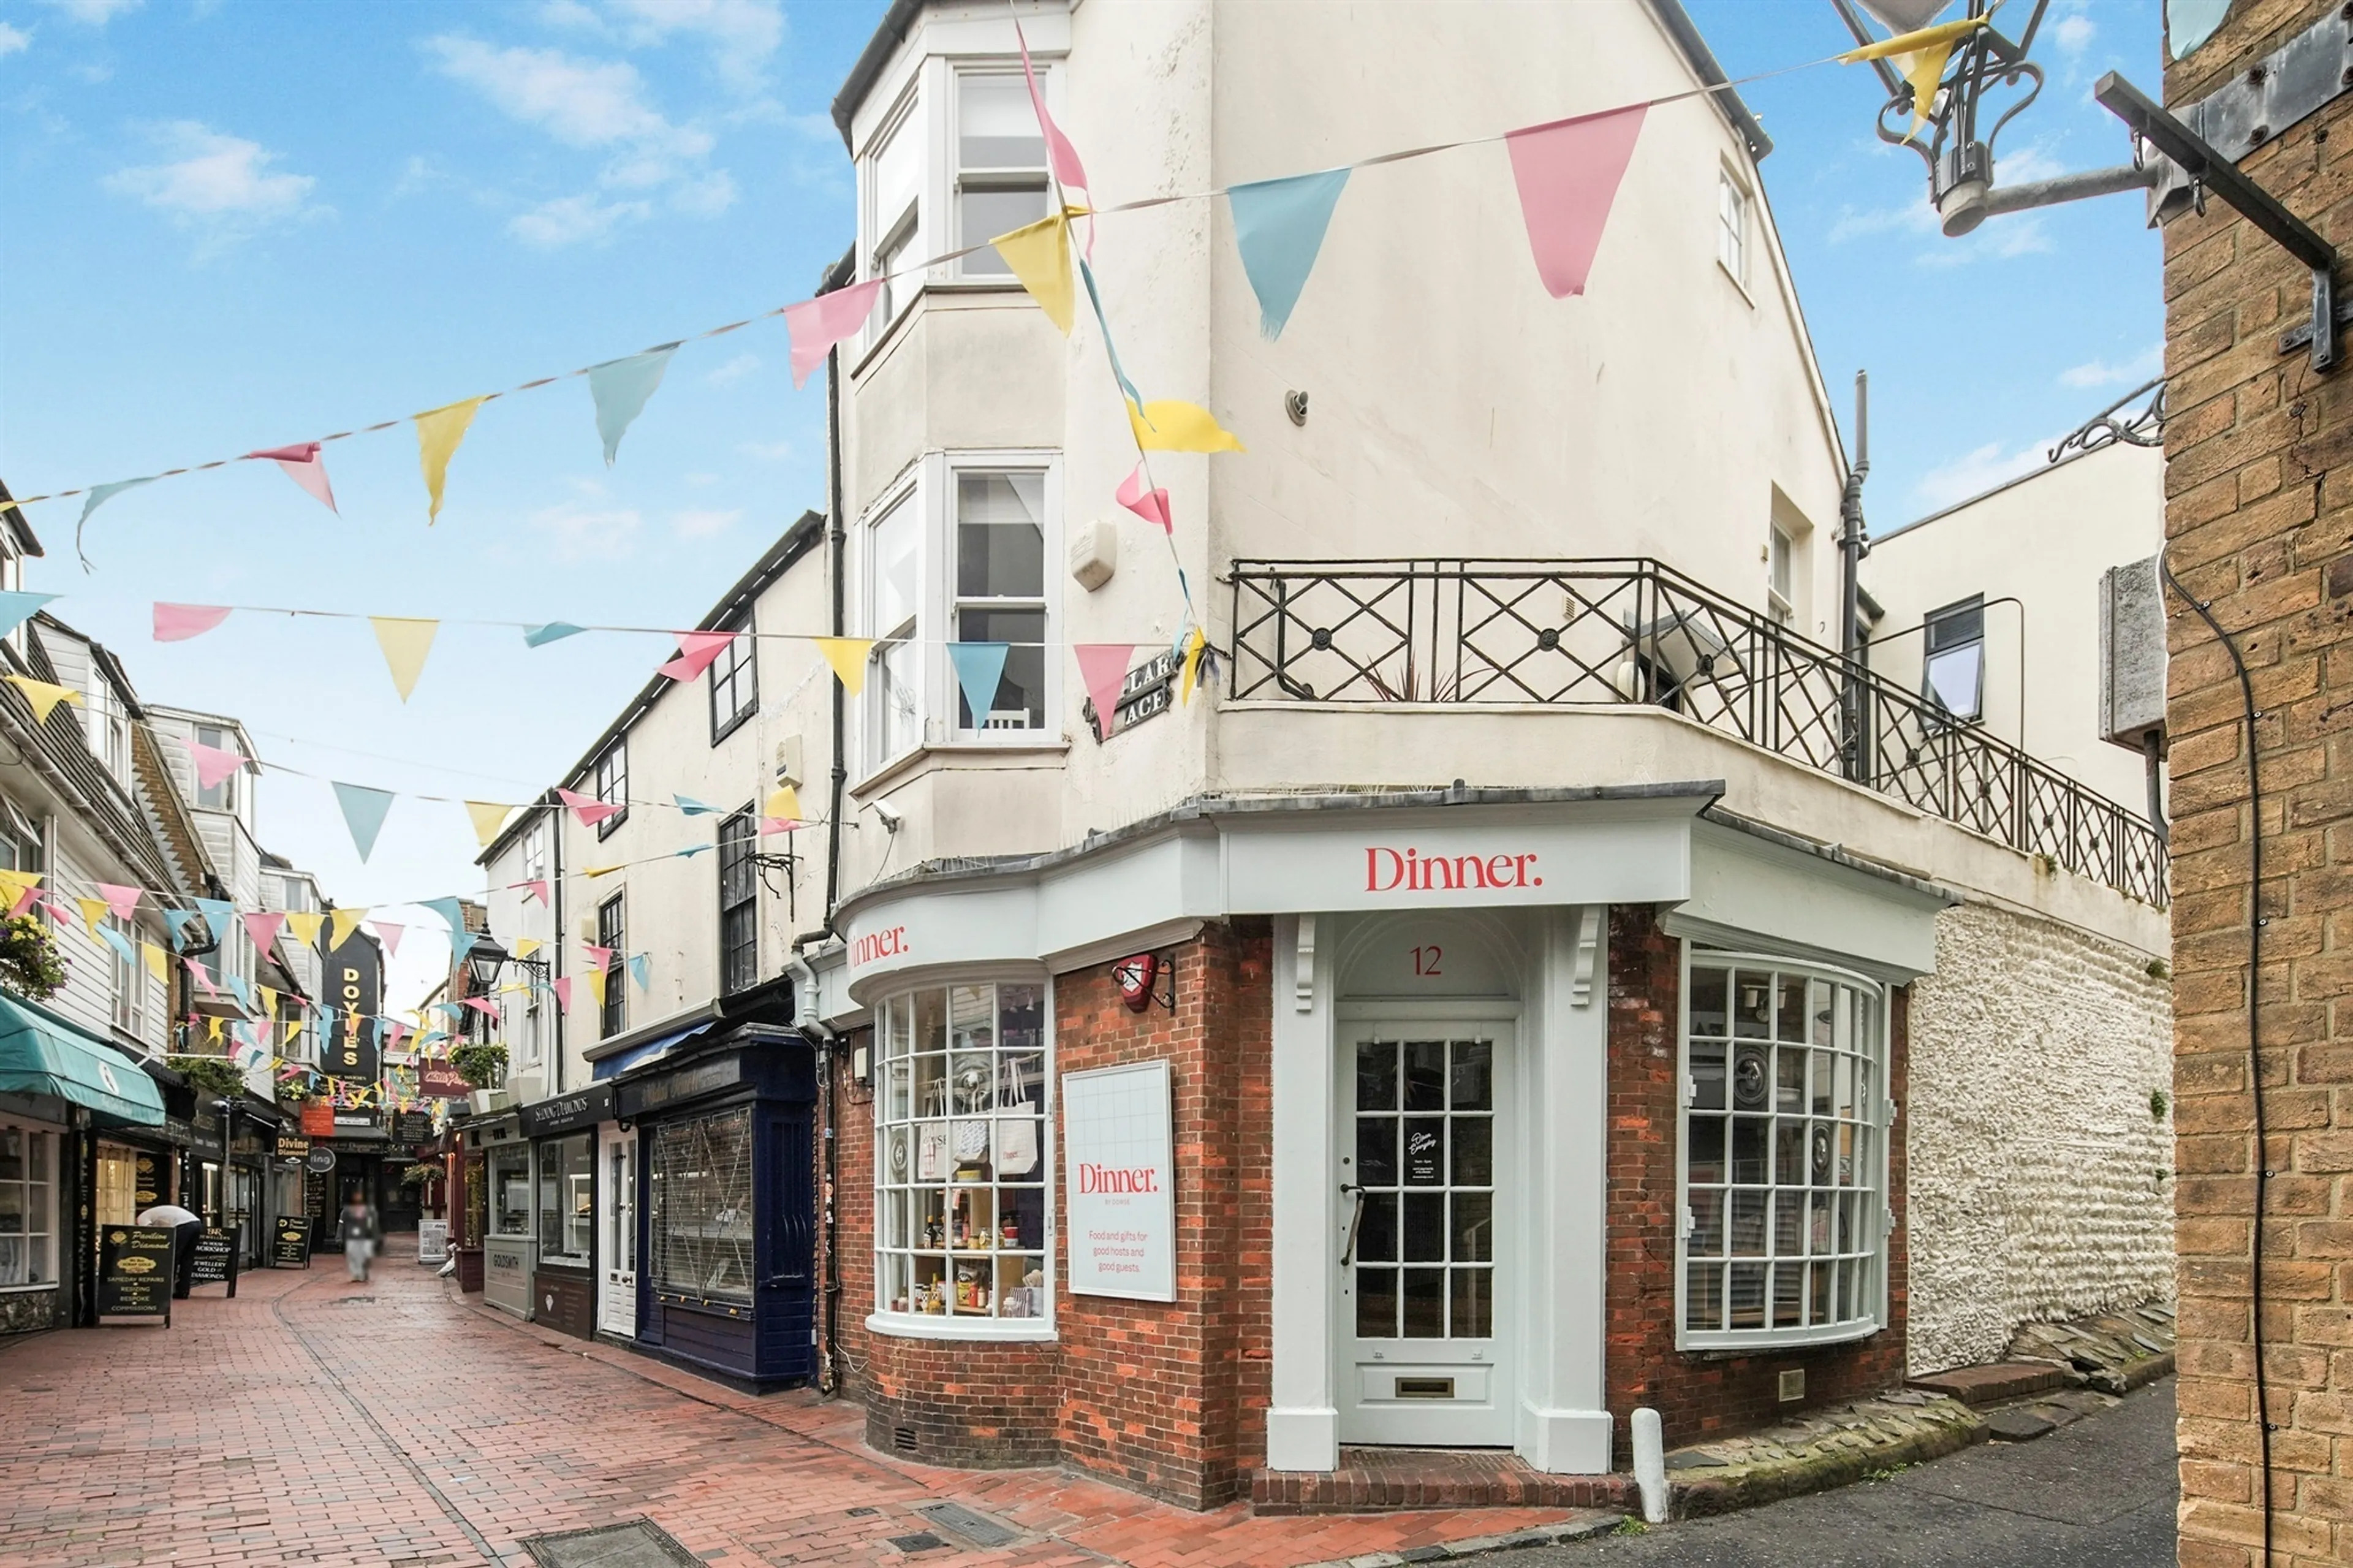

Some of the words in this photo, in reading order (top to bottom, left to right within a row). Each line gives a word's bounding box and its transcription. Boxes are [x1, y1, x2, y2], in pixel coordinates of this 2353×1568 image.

[1365, 847, 1543, 892] Dinner.
[1410, 945, 1442, 975] 12
[278, 1137, 309, 1148] Divine
[1079, 1164, 1158, 1194] Dinner.
[132, 1230, 167, 1240] Pavilion
[1089, 1230, 1105, 1240] Food
[1107, 1231, 1119, 1241] and
[1120, 1230, 1136, 1243] gifts
[1137, 1231, 1148, 1241] for
[131, 1240, 172, 1249] Diamond
[1093, 1246, 1110, 1257] good
[1110, 1246, 1129, 1257] hosts
[1131, 1248, 1144, 1257] and
[493, 1253, 519, 1271] GOLDSMITH
[1098, 1262, 1115, 1273] good
[1116, 1263, 1141, 1273] guests.
